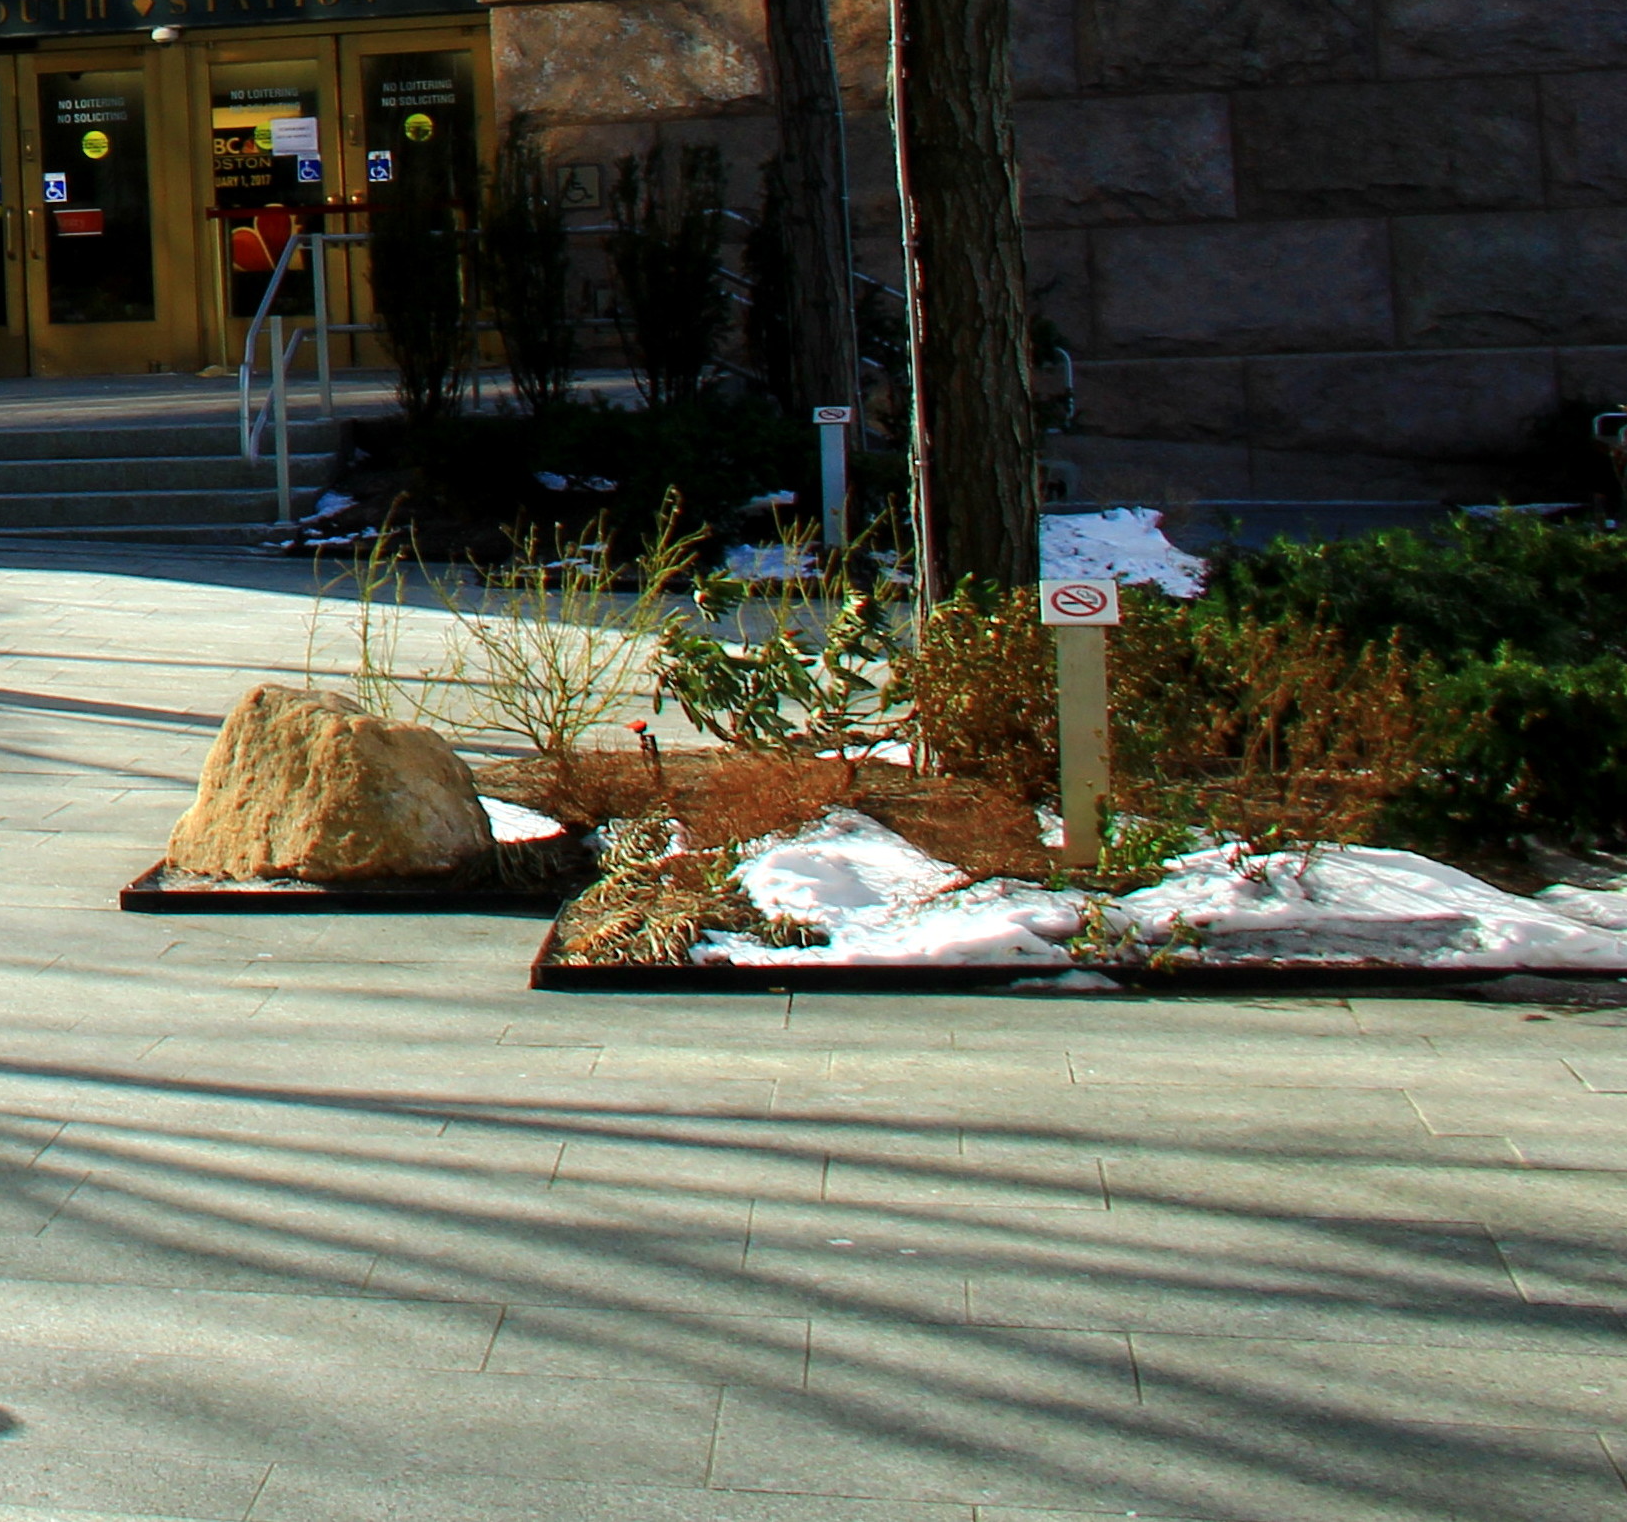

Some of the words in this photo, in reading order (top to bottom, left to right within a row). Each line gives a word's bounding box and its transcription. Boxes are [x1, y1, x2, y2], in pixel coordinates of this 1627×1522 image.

[383, 82, 397, 92] NO
[399, 79, 452, 91] LOITERING
[230, 90, 245, 100] NO
[247, 87, 299, 99] LOITERING
[58, 99, 72, 110] NO
[74, 96, 125, 109] LOITERING
[382, 97, 396, 107] NO
[399, 94, 455, 106] SOLICITING
[57, 113, 71, 124] NO
[73, 110, 128, 123] SOLICITING
[213, 137, 240, 155] BC
[213, 157, 272, 170] OSTON
[215, 175, 239, 188] UARY
